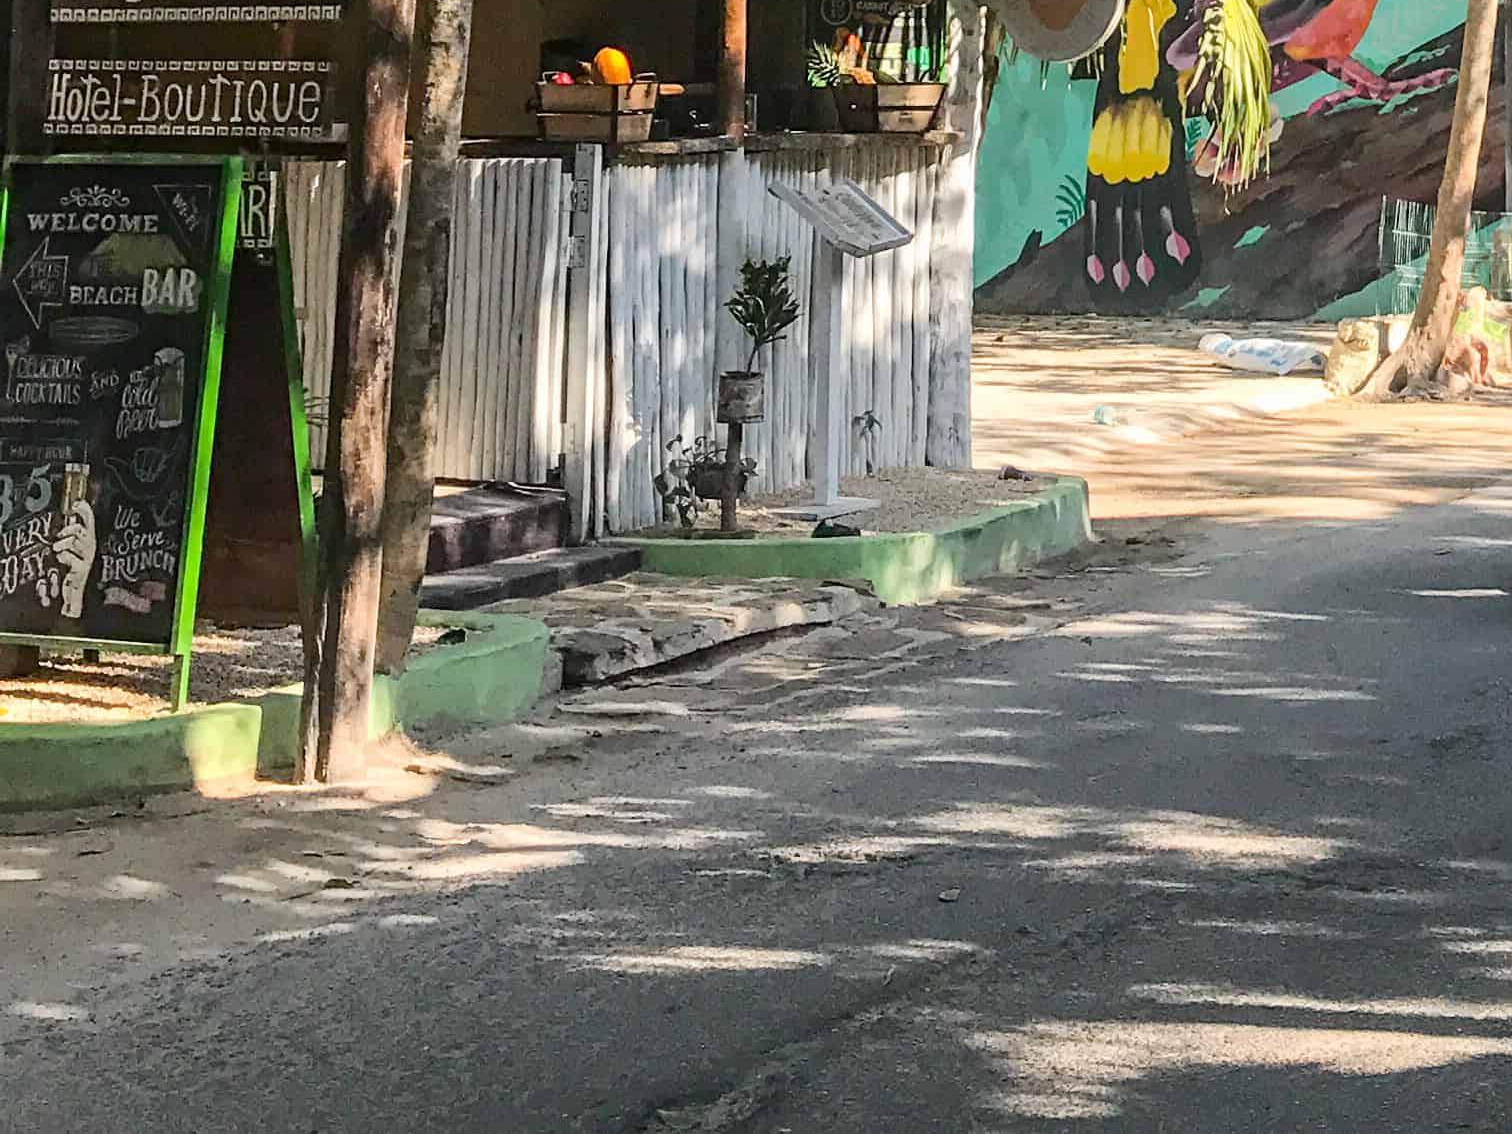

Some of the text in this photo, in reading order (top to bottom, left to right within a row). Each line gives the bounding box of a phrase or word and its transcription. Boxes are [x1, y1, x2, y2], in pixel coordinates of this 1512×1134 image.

[27, 213, 159, 233] WELCOME
[69, 268, 197, 307] BEACH BAR
[16, 383, 81, 404] COCKTAILS
[25, 463, 51, 512] 5
[114, 505, 140, 530] We
[2, 512, 53, 554] VERY
[116, 529, 165, 555] Serve
[101, 549, 176, 582] BRUNCH
